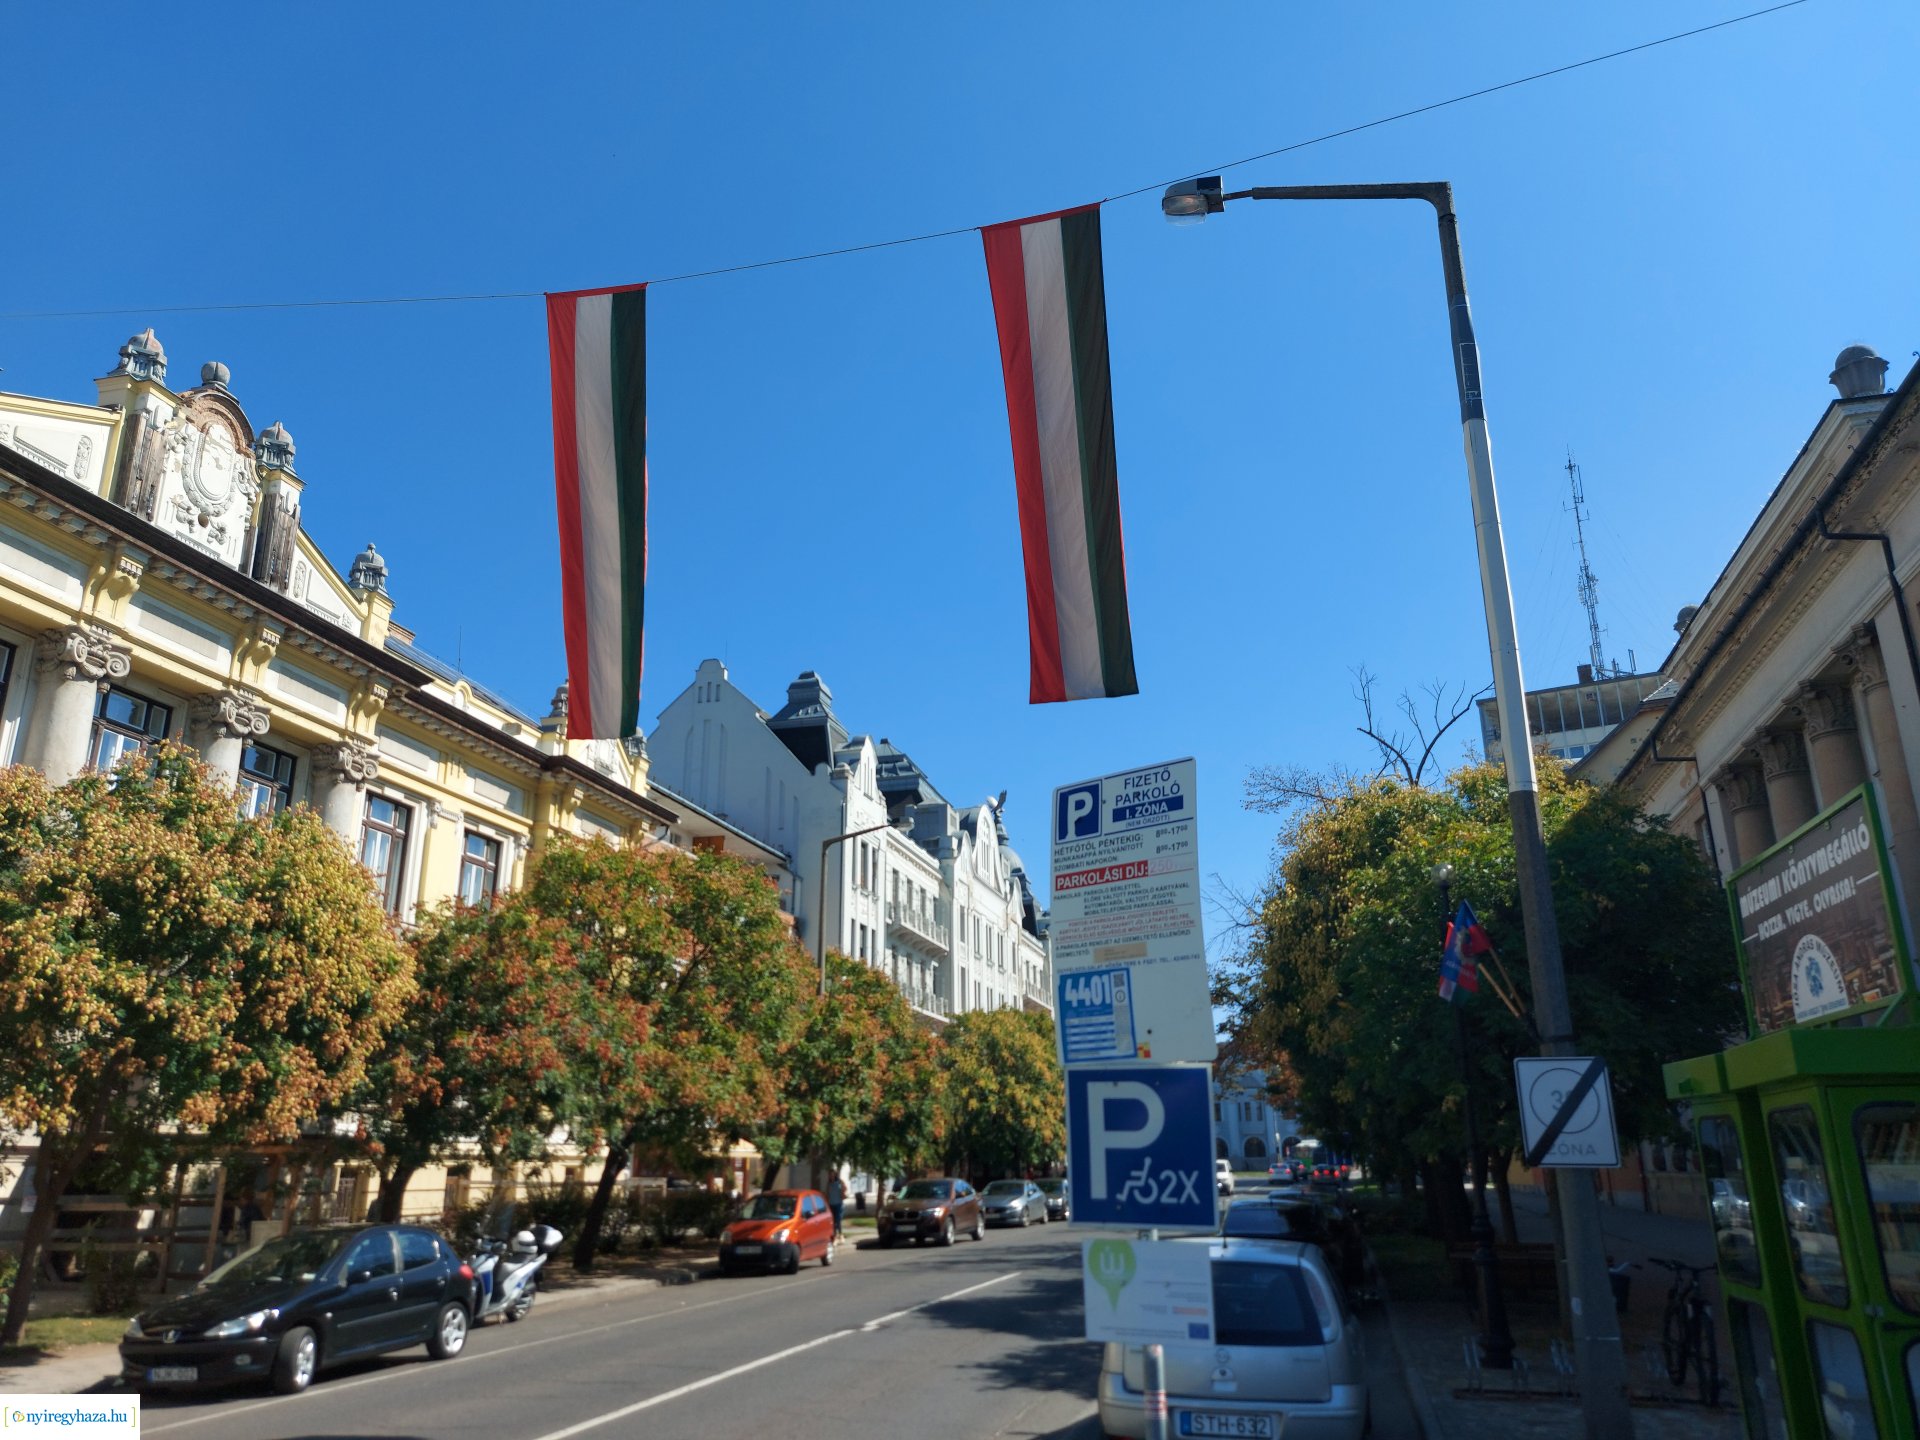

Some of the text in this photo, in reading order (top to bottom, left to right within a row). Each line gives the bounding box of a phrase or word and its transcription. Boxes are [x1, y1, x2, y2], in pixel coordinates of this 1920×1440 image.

[1115, 780, 1181, 806] PARKOLÓ
[1124, 767, 1171, 790] FIZETŐ
[1064, 791, 1094, 840] P
[1126, 801, 1169, 819] I. ZÓNA
[1098, 833, 1144, 848] PÉNTEKIG:
[1057, 866, 1123, 889] PARKOLÁSI
[1126, 862, 1149, 877] DÍJ:
[1739, 816, 1871, 919] MÚZEUMI KÖNYVMEGÁLLÓ
[1813, 876, 1856, 913] OLVASSA!
[1064, 973, 1112, 1008] 4401
[1086, 1080, 1166, 1200] P
[1159, 1169, 1200, 1205] 2X
[1193, 1415, 1267, 1436] STH-632
